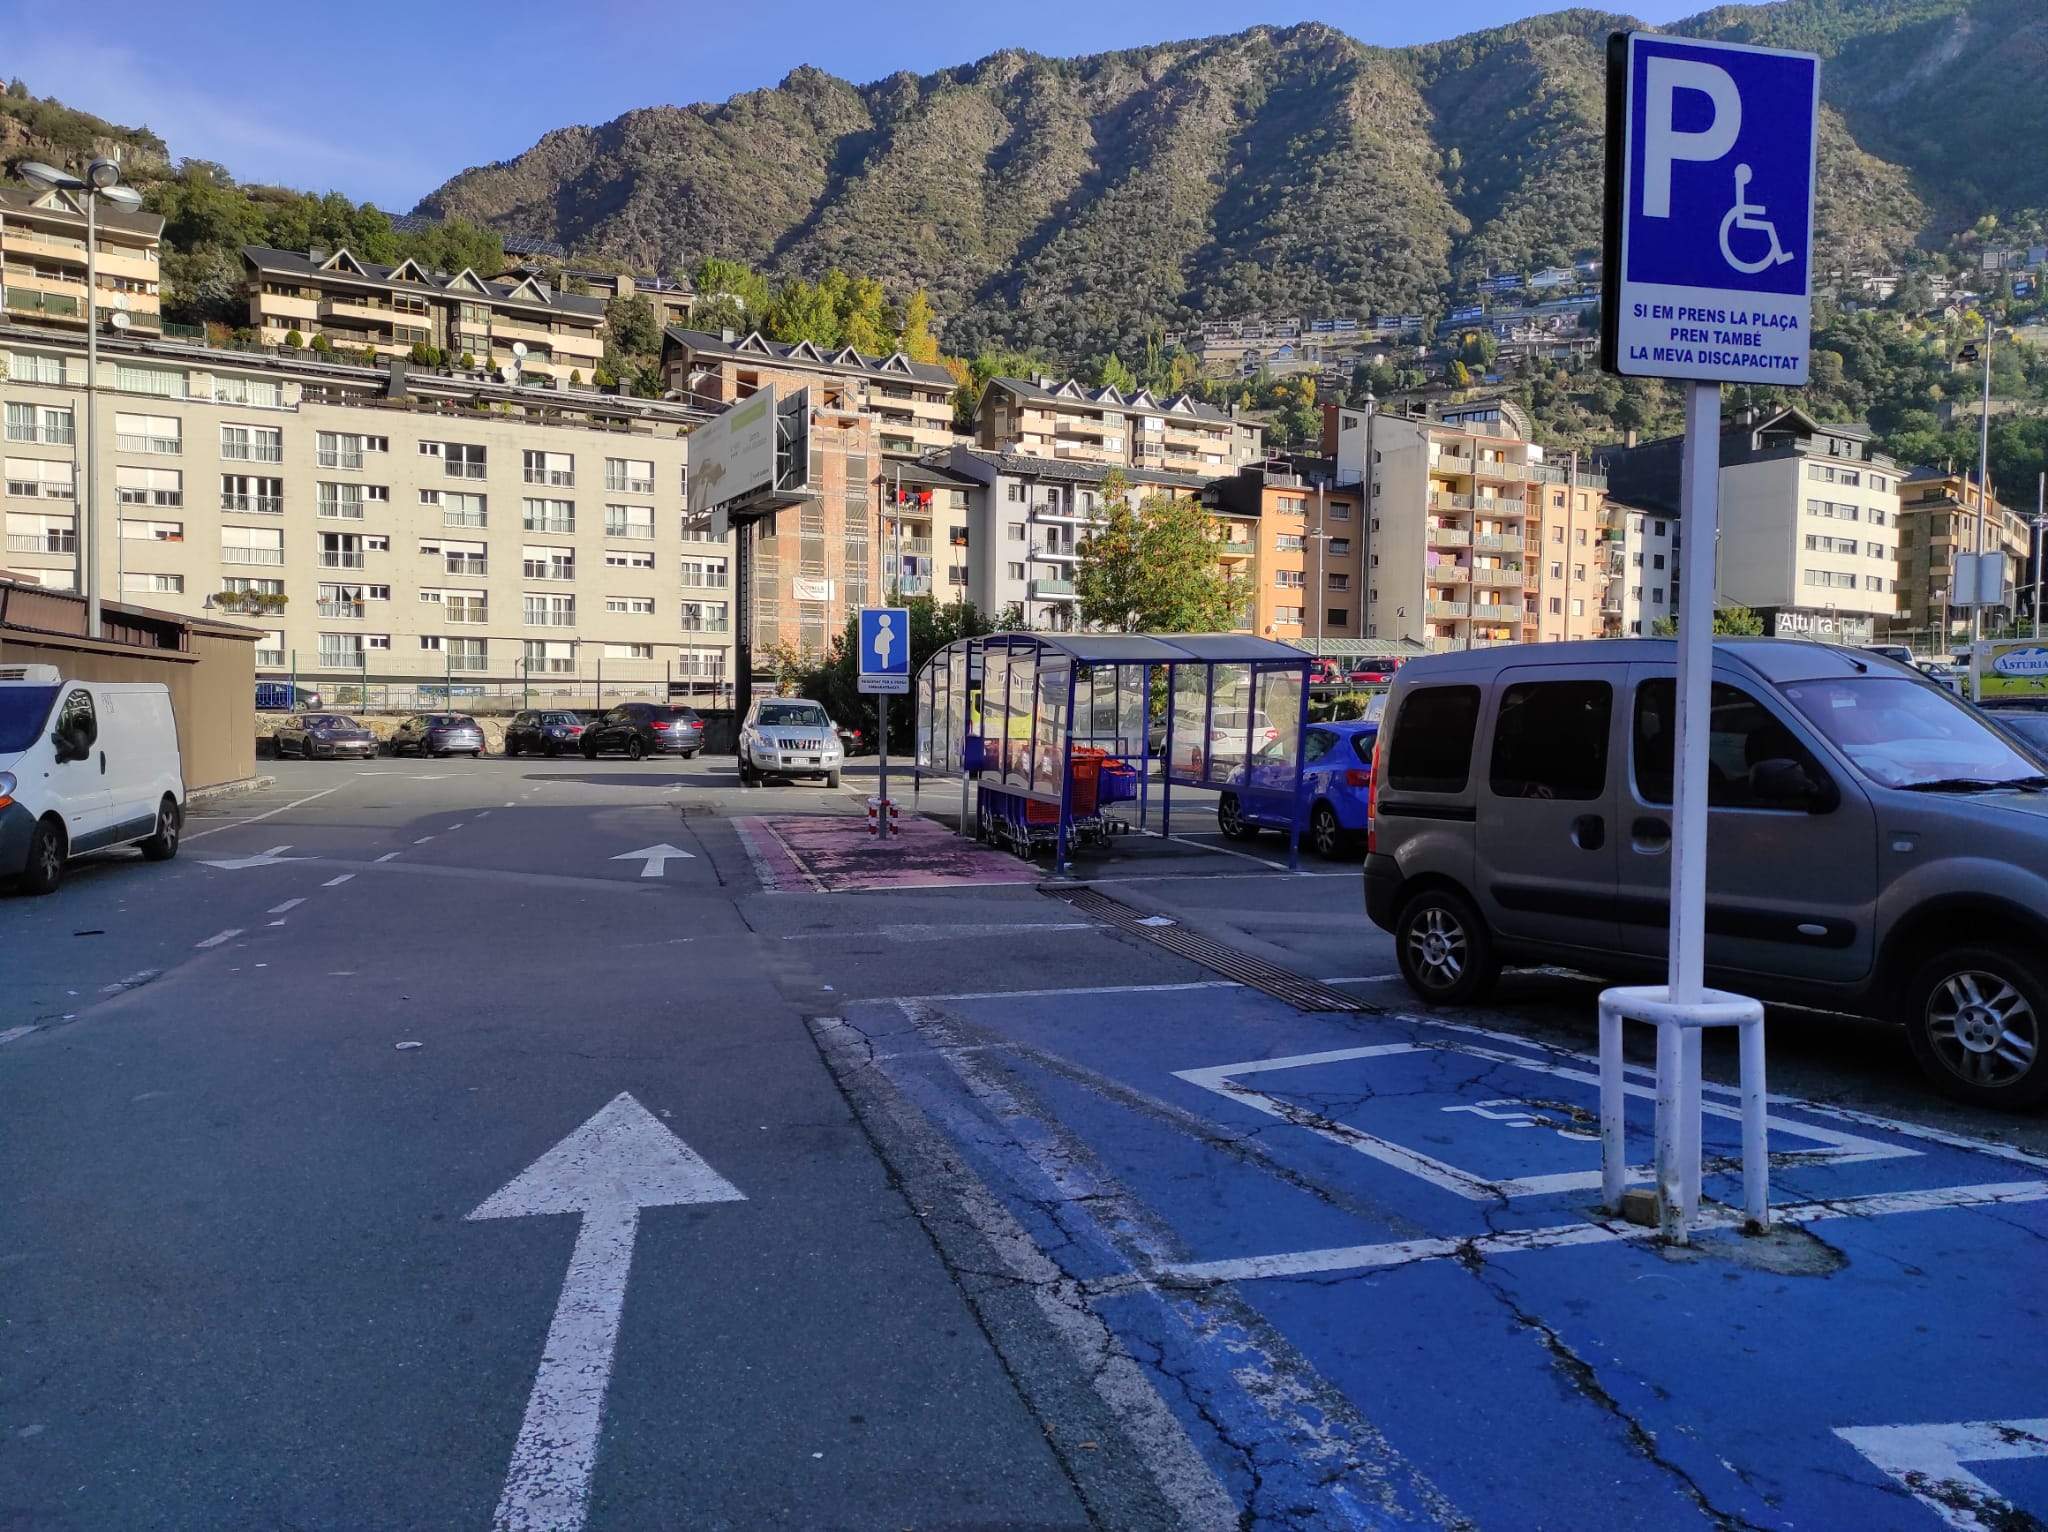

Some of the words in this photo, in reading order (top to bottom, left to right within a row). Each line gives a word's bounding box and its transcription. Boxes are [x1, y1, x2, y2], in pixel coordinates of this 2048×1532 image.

[1642, 55, 1743, 218] P
[1633, 303, 1648, 318] SI
[1652, 305, 1674, 320] EM
[1678, 307, 1726, 324] PRENS
[1730, 311, 1748, 325] LA
[1752, 313, 1798, 331] PLAÇA
[1670, 328, 1709, 343] PREN
[1713, 331, 1762, 347] TAMBÉ
[1630, 346, 1648, 360] LA
[1653, 347, 1694, 364] MEVA
[1698, 350, 1799, 370] DISCAPACITAT
[1780, 613, 1833, 633] Altura
